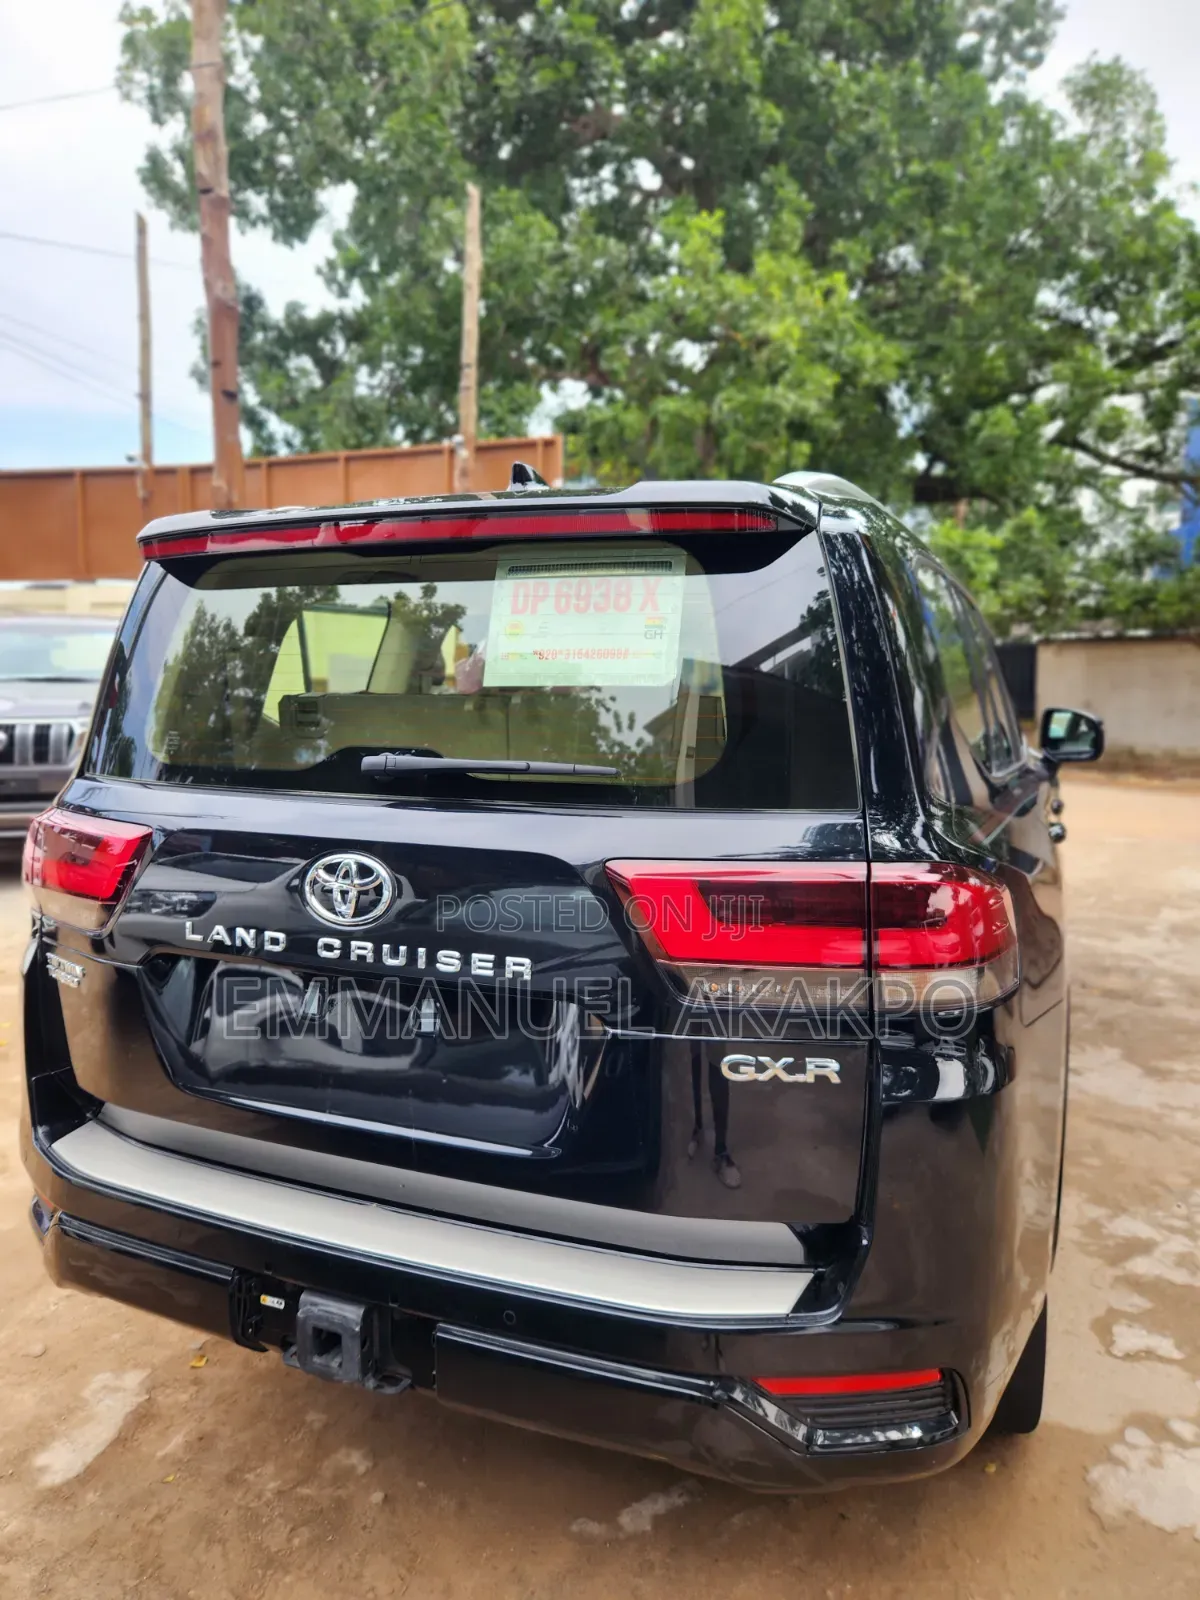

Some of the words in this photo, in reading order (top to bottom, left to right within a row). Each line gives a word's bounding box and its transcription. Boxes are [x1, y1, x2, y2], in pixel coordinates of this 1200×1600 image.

[511, 580, 549, 615] DP
[554, 577, 633, 614] 6938
[639, 577, 665, 612] X
[644, 629, 663, 640] GH
[184, 921, 287, 952] LAND
[317, 937, 532, 981] CRUISER
